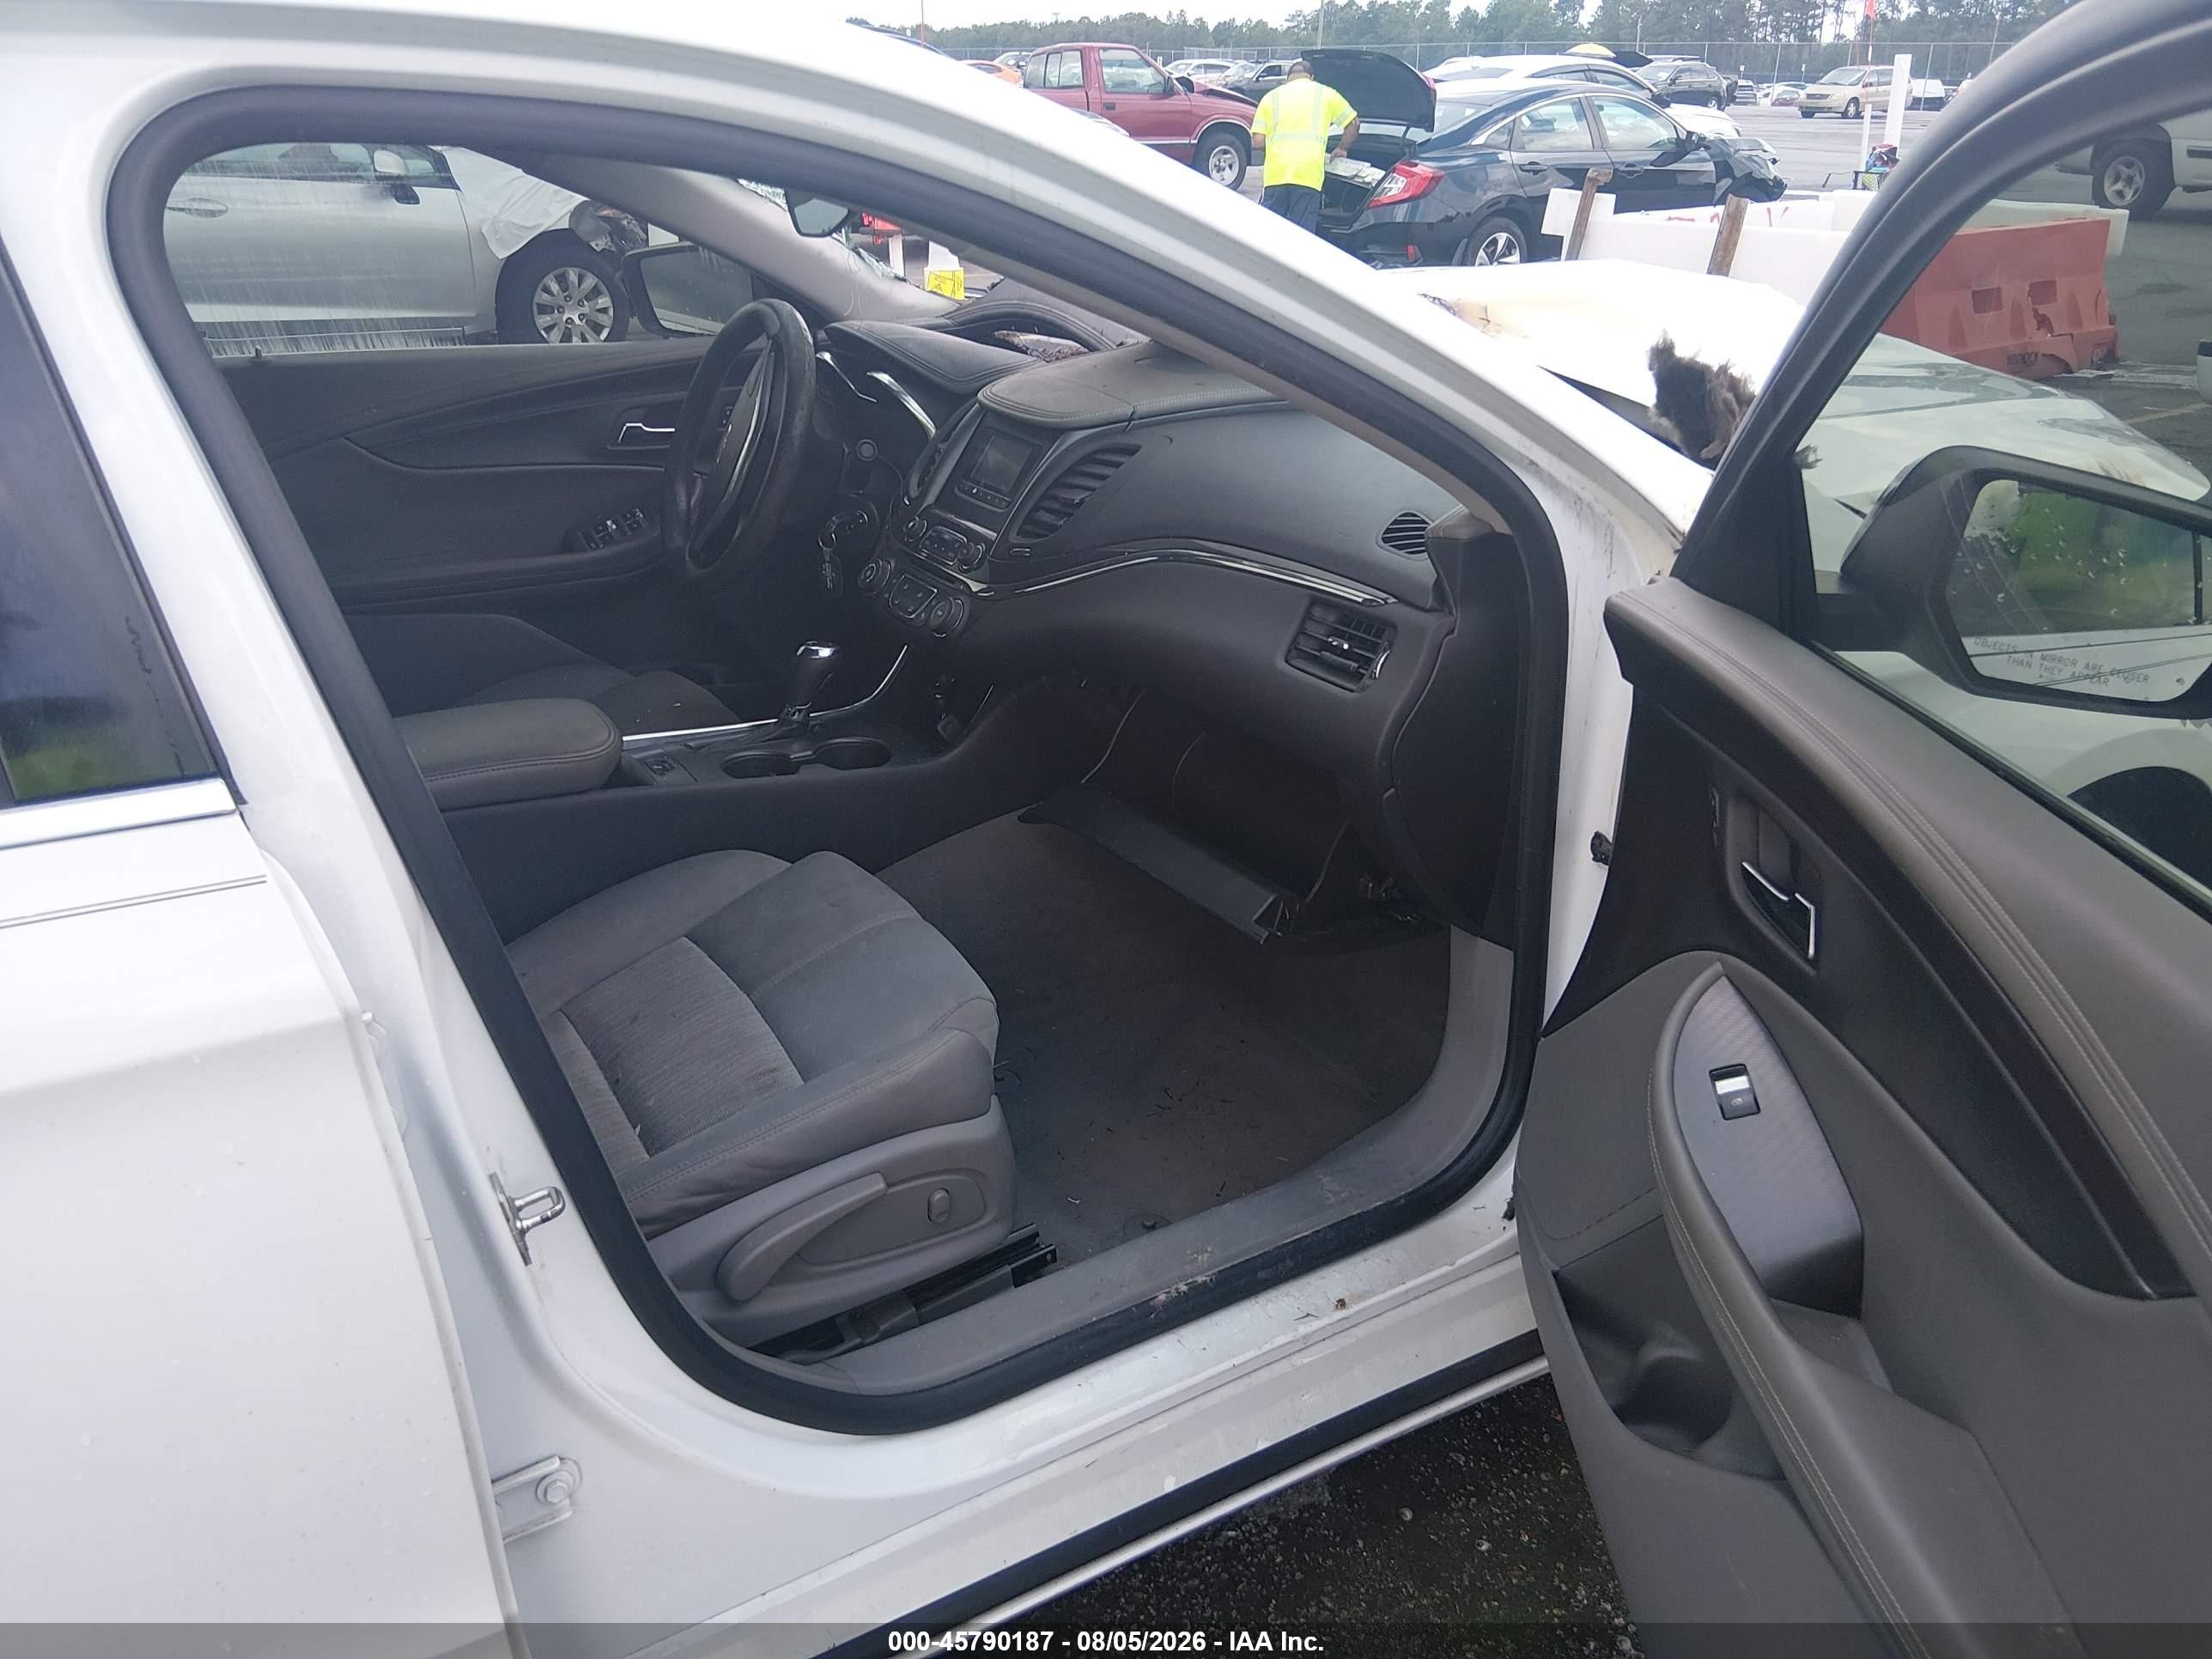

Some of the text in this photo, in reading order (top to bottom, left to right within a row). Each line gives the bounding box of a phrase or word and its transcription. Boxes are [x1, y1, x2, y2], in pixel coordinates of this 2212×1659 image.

[1973, 637, 2019, 653] OBJECTS
[2039, 653, 2079, 669] MIRROR
[2083, 661, 2104, 673] ARE
[2006, 655, 2034, 670] THAN
[2039, 663, 2063, 676] THEY
